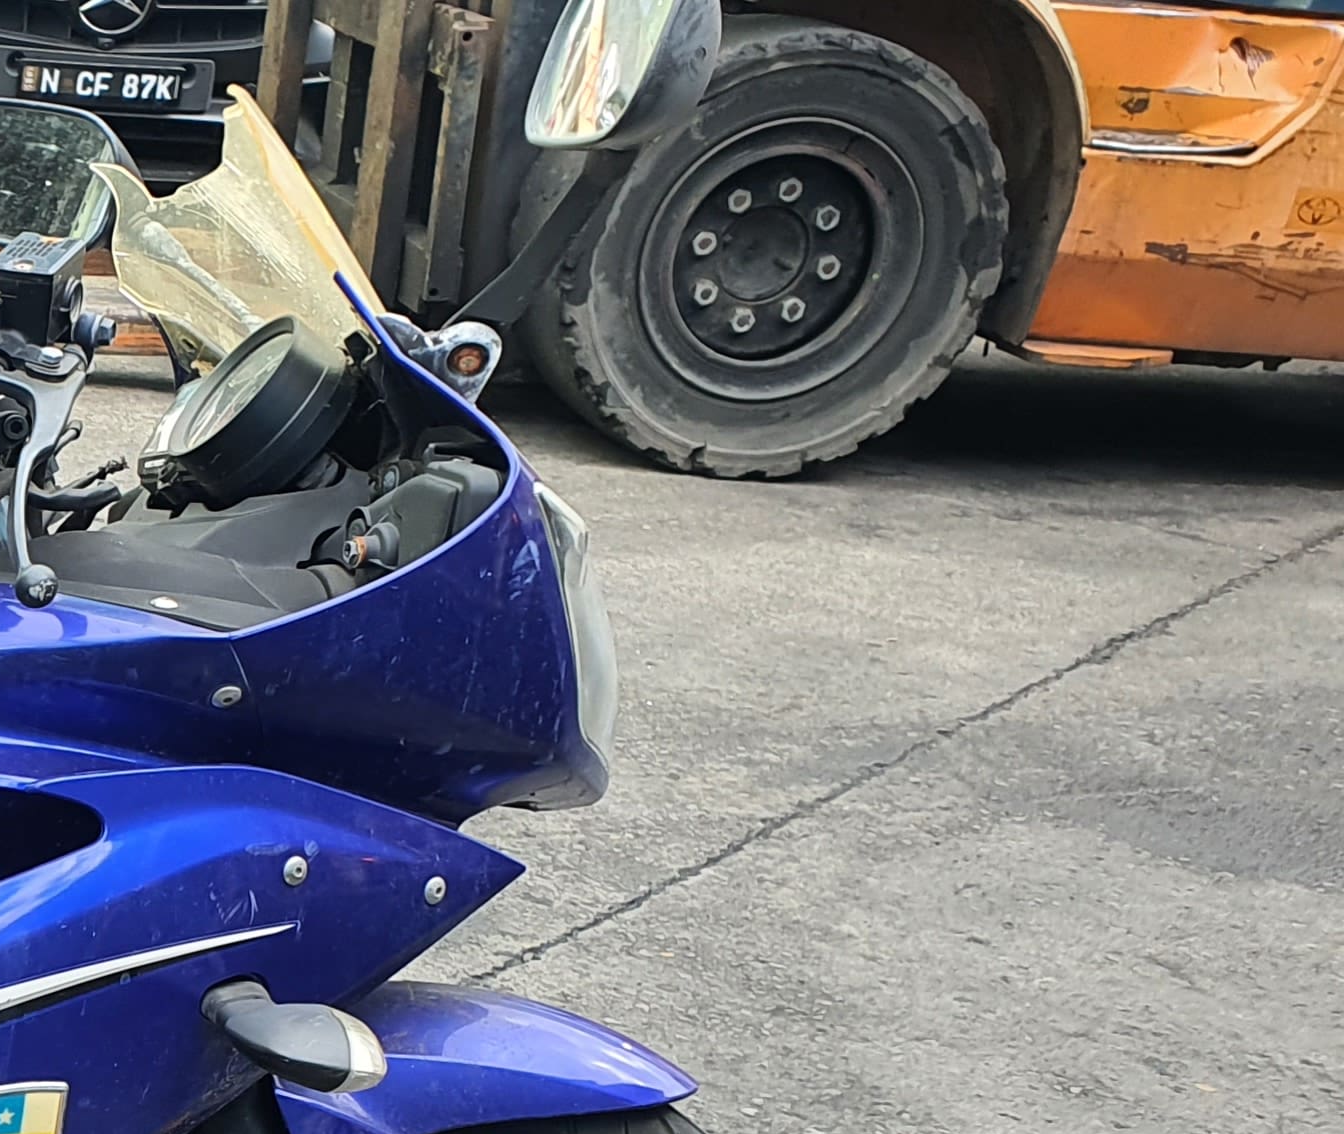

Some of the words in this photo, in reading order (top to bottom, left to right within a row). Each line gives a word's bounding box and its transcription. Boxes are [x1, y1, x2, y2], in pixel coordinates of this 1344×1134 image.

[40, 67, 61, 94] N
[75, 71, 114, 97] CF
[122, 73, 176, 100] 87K
